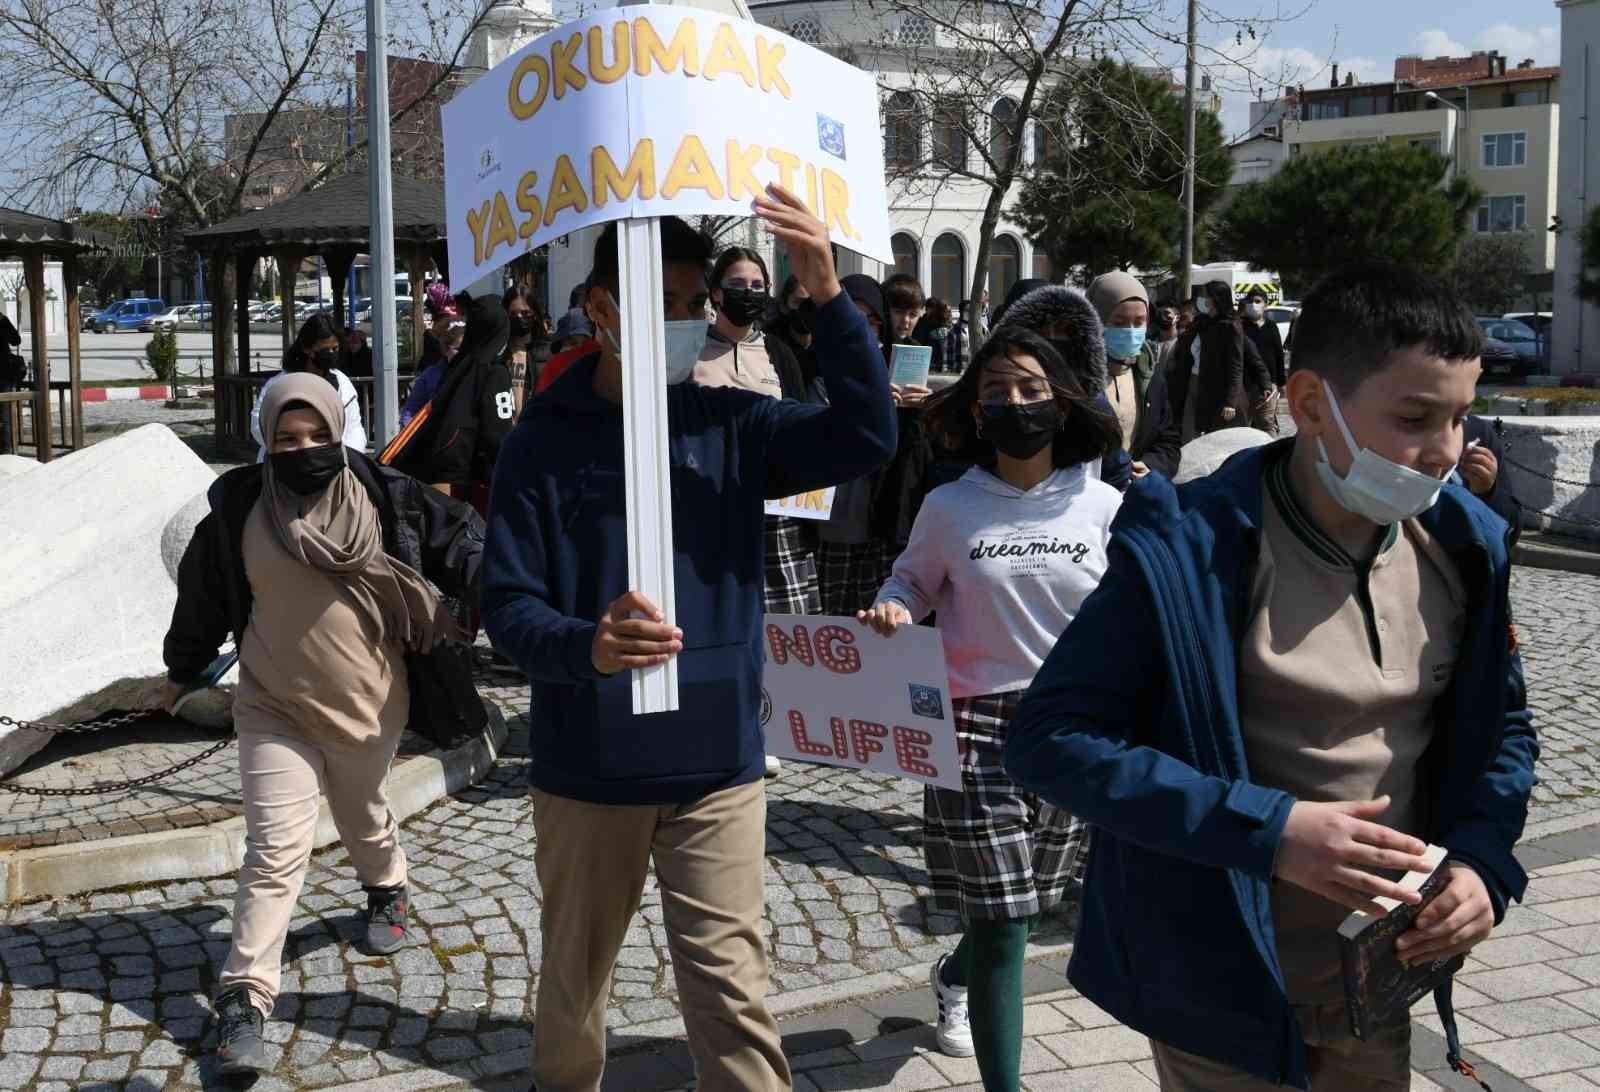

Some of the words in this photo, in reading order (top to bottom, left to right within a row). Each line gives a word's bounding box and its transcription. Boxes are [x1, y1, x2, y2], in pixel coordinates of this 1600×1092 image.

[508, 16, 793, 121] OKUMAK
[495, 389, 515, 419] 8
[969, 537, 1090, 563] dreaming
[765, 623, 862, 674] NG
[788, 709, 938, 778] LIFE
